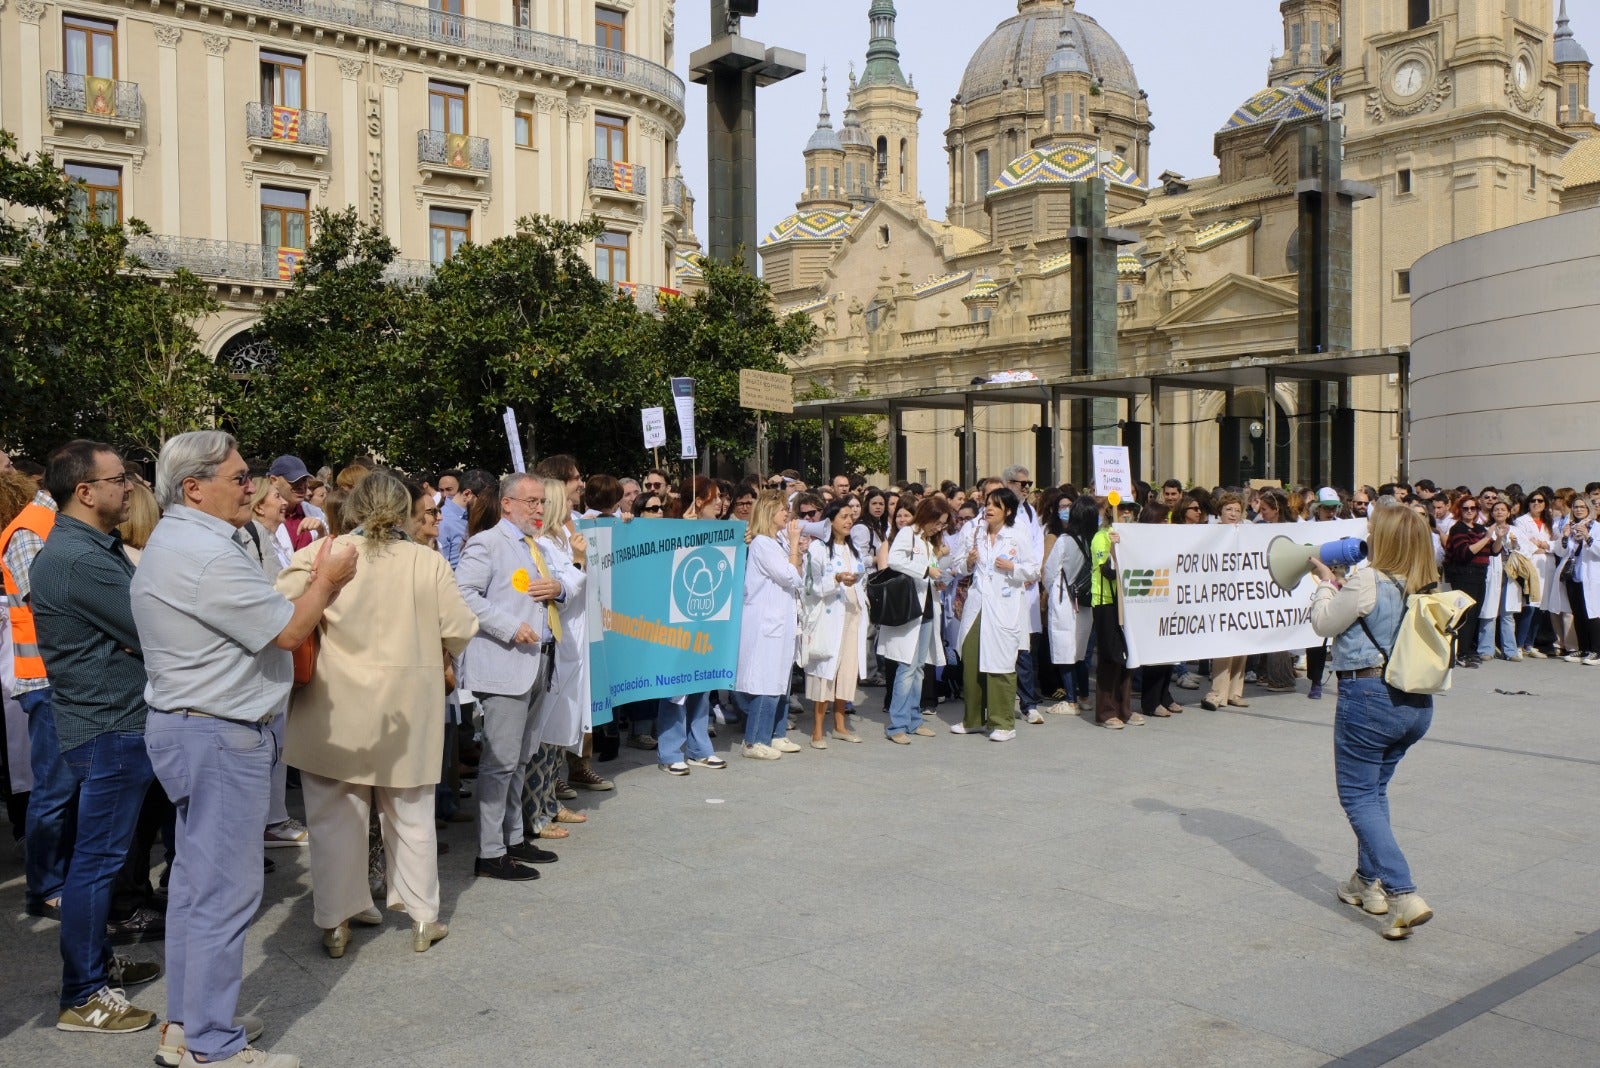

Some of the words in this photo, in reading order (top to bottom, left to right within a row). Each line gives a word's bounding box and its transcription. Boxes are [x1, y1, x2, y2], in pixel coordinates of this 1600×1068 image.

[367, 86, 381, 138] LAS
[369, 151, 382, 225] TORR
[684, 528, 735, 546] COMPUTADA
[1176, 553, 1199, 574] POR
[1201, 552, 1219, 573] UN
[1221, 551, 1269, 572] ESTATU
[1176, 585, 1192, 605] DE
[1194, 583, 1208, 603] LA
[602, 607, 692, 651] econocimiento
[1158, 611, 1206, 637] MÉDICA
[1207, 614, 1217, 633] Y
[1219, 607, 1312, 632] FACULTATIVA
[609, 676, 652, 697] egociación.
[655, 673, 693, 687] Nuestro
[694, 668, 734, 682] Estatuto
